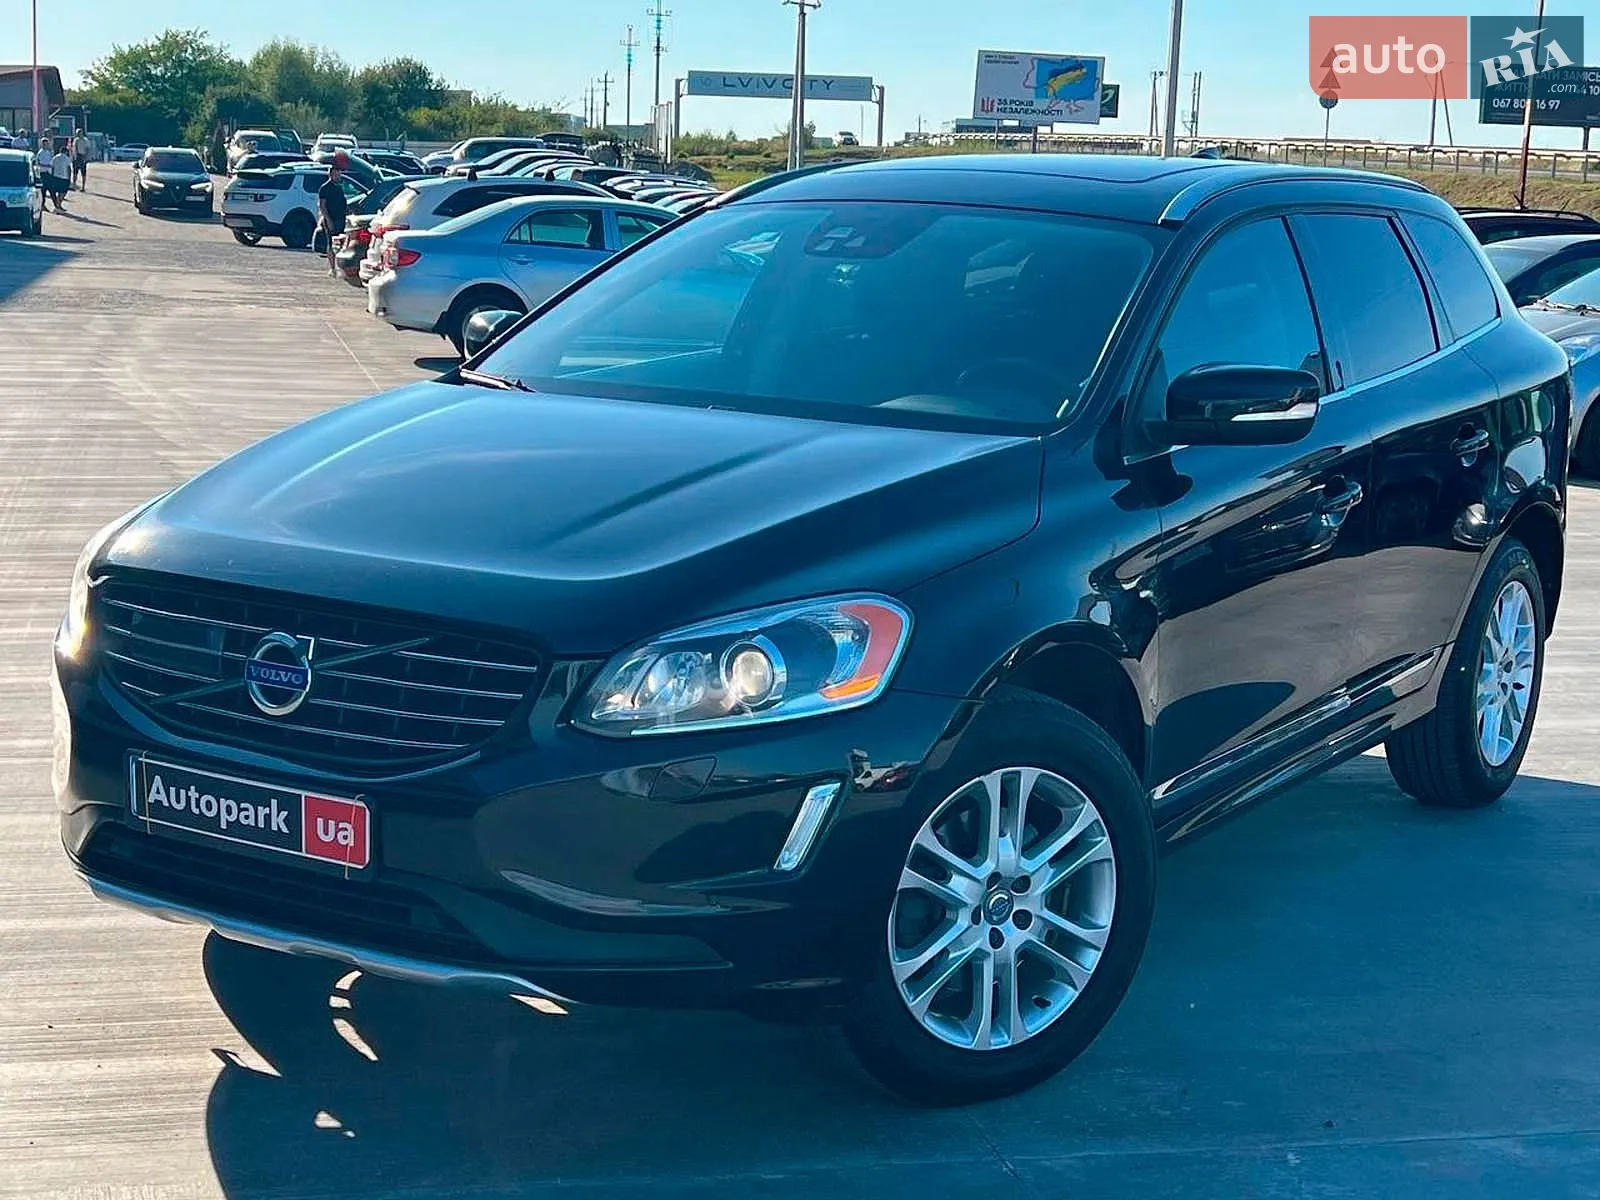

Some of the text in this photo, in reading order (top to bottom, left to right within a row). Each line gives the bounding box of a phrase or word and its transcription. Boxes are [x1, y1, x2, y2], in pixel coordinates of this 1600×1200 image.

[1492, 98, 1561, 110] 067 80 16 97
[249, 664, 304, 686] VOLVO
[148, 774, 355, 847] Autopark ua
